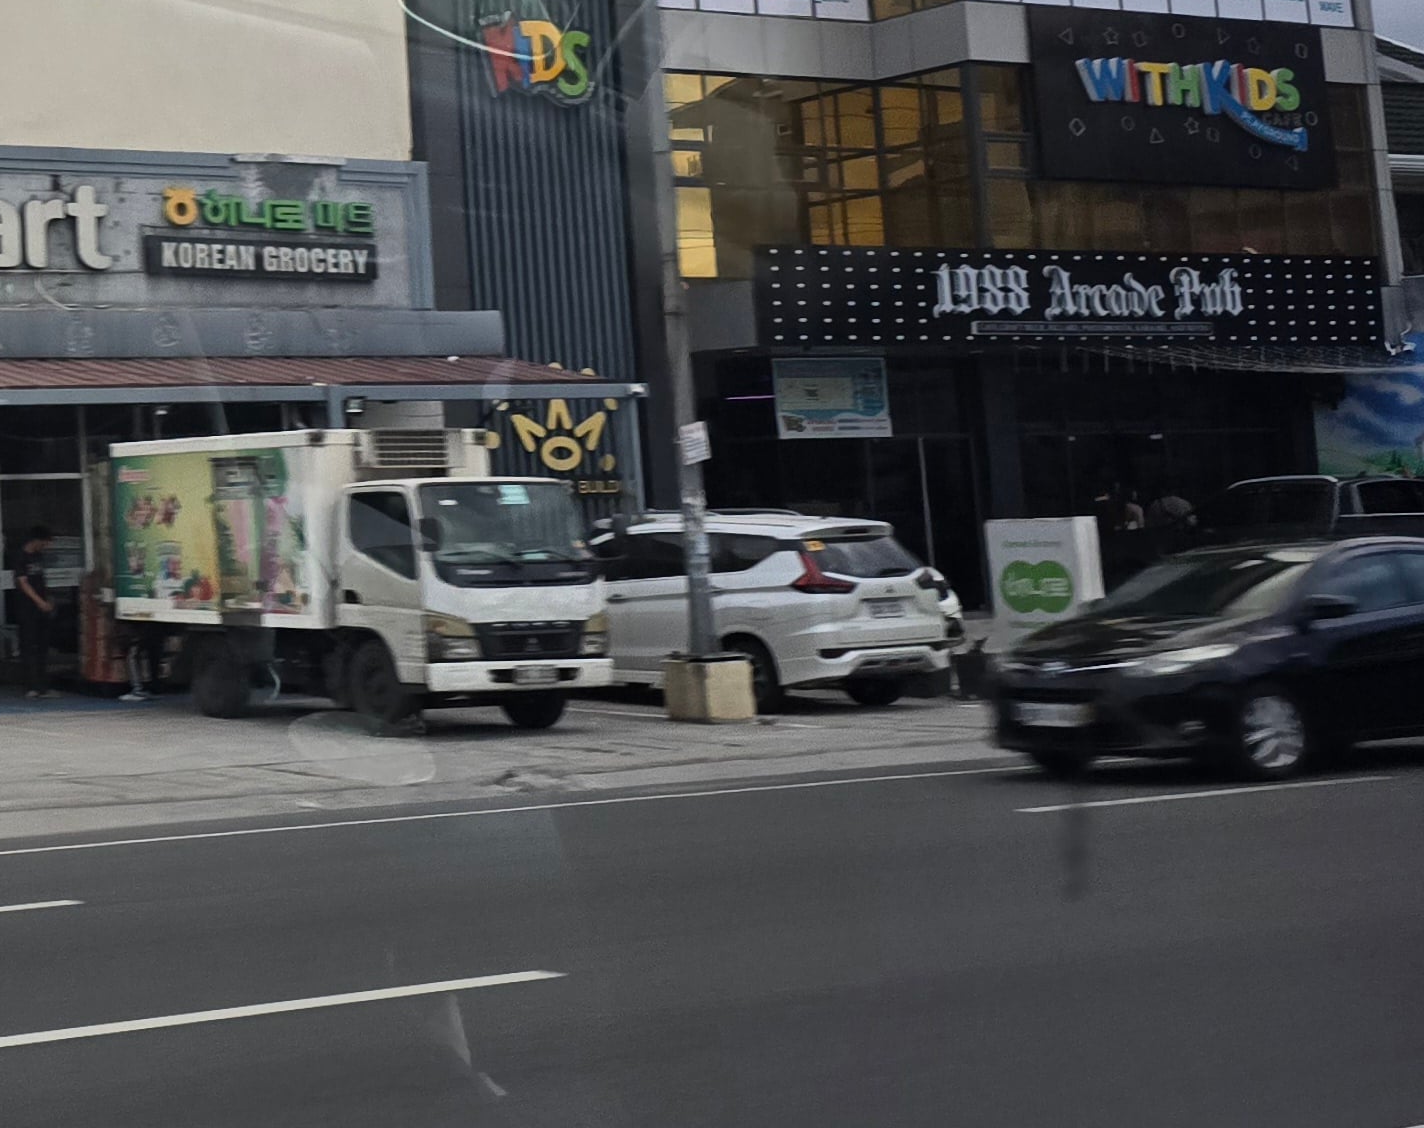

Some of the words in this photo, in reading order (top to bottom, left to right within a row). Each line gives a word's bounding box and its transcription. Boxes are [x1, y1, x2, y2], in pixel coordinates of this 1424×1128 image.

[161, 241, 256, 271] KOREAN
[262, 245, 369, 274] GROCERY
[929, 262, 1031, 319] 1988
[1041, 264, 1167, 321] Arcade
[1170, 266, 1244, 321] Pub
